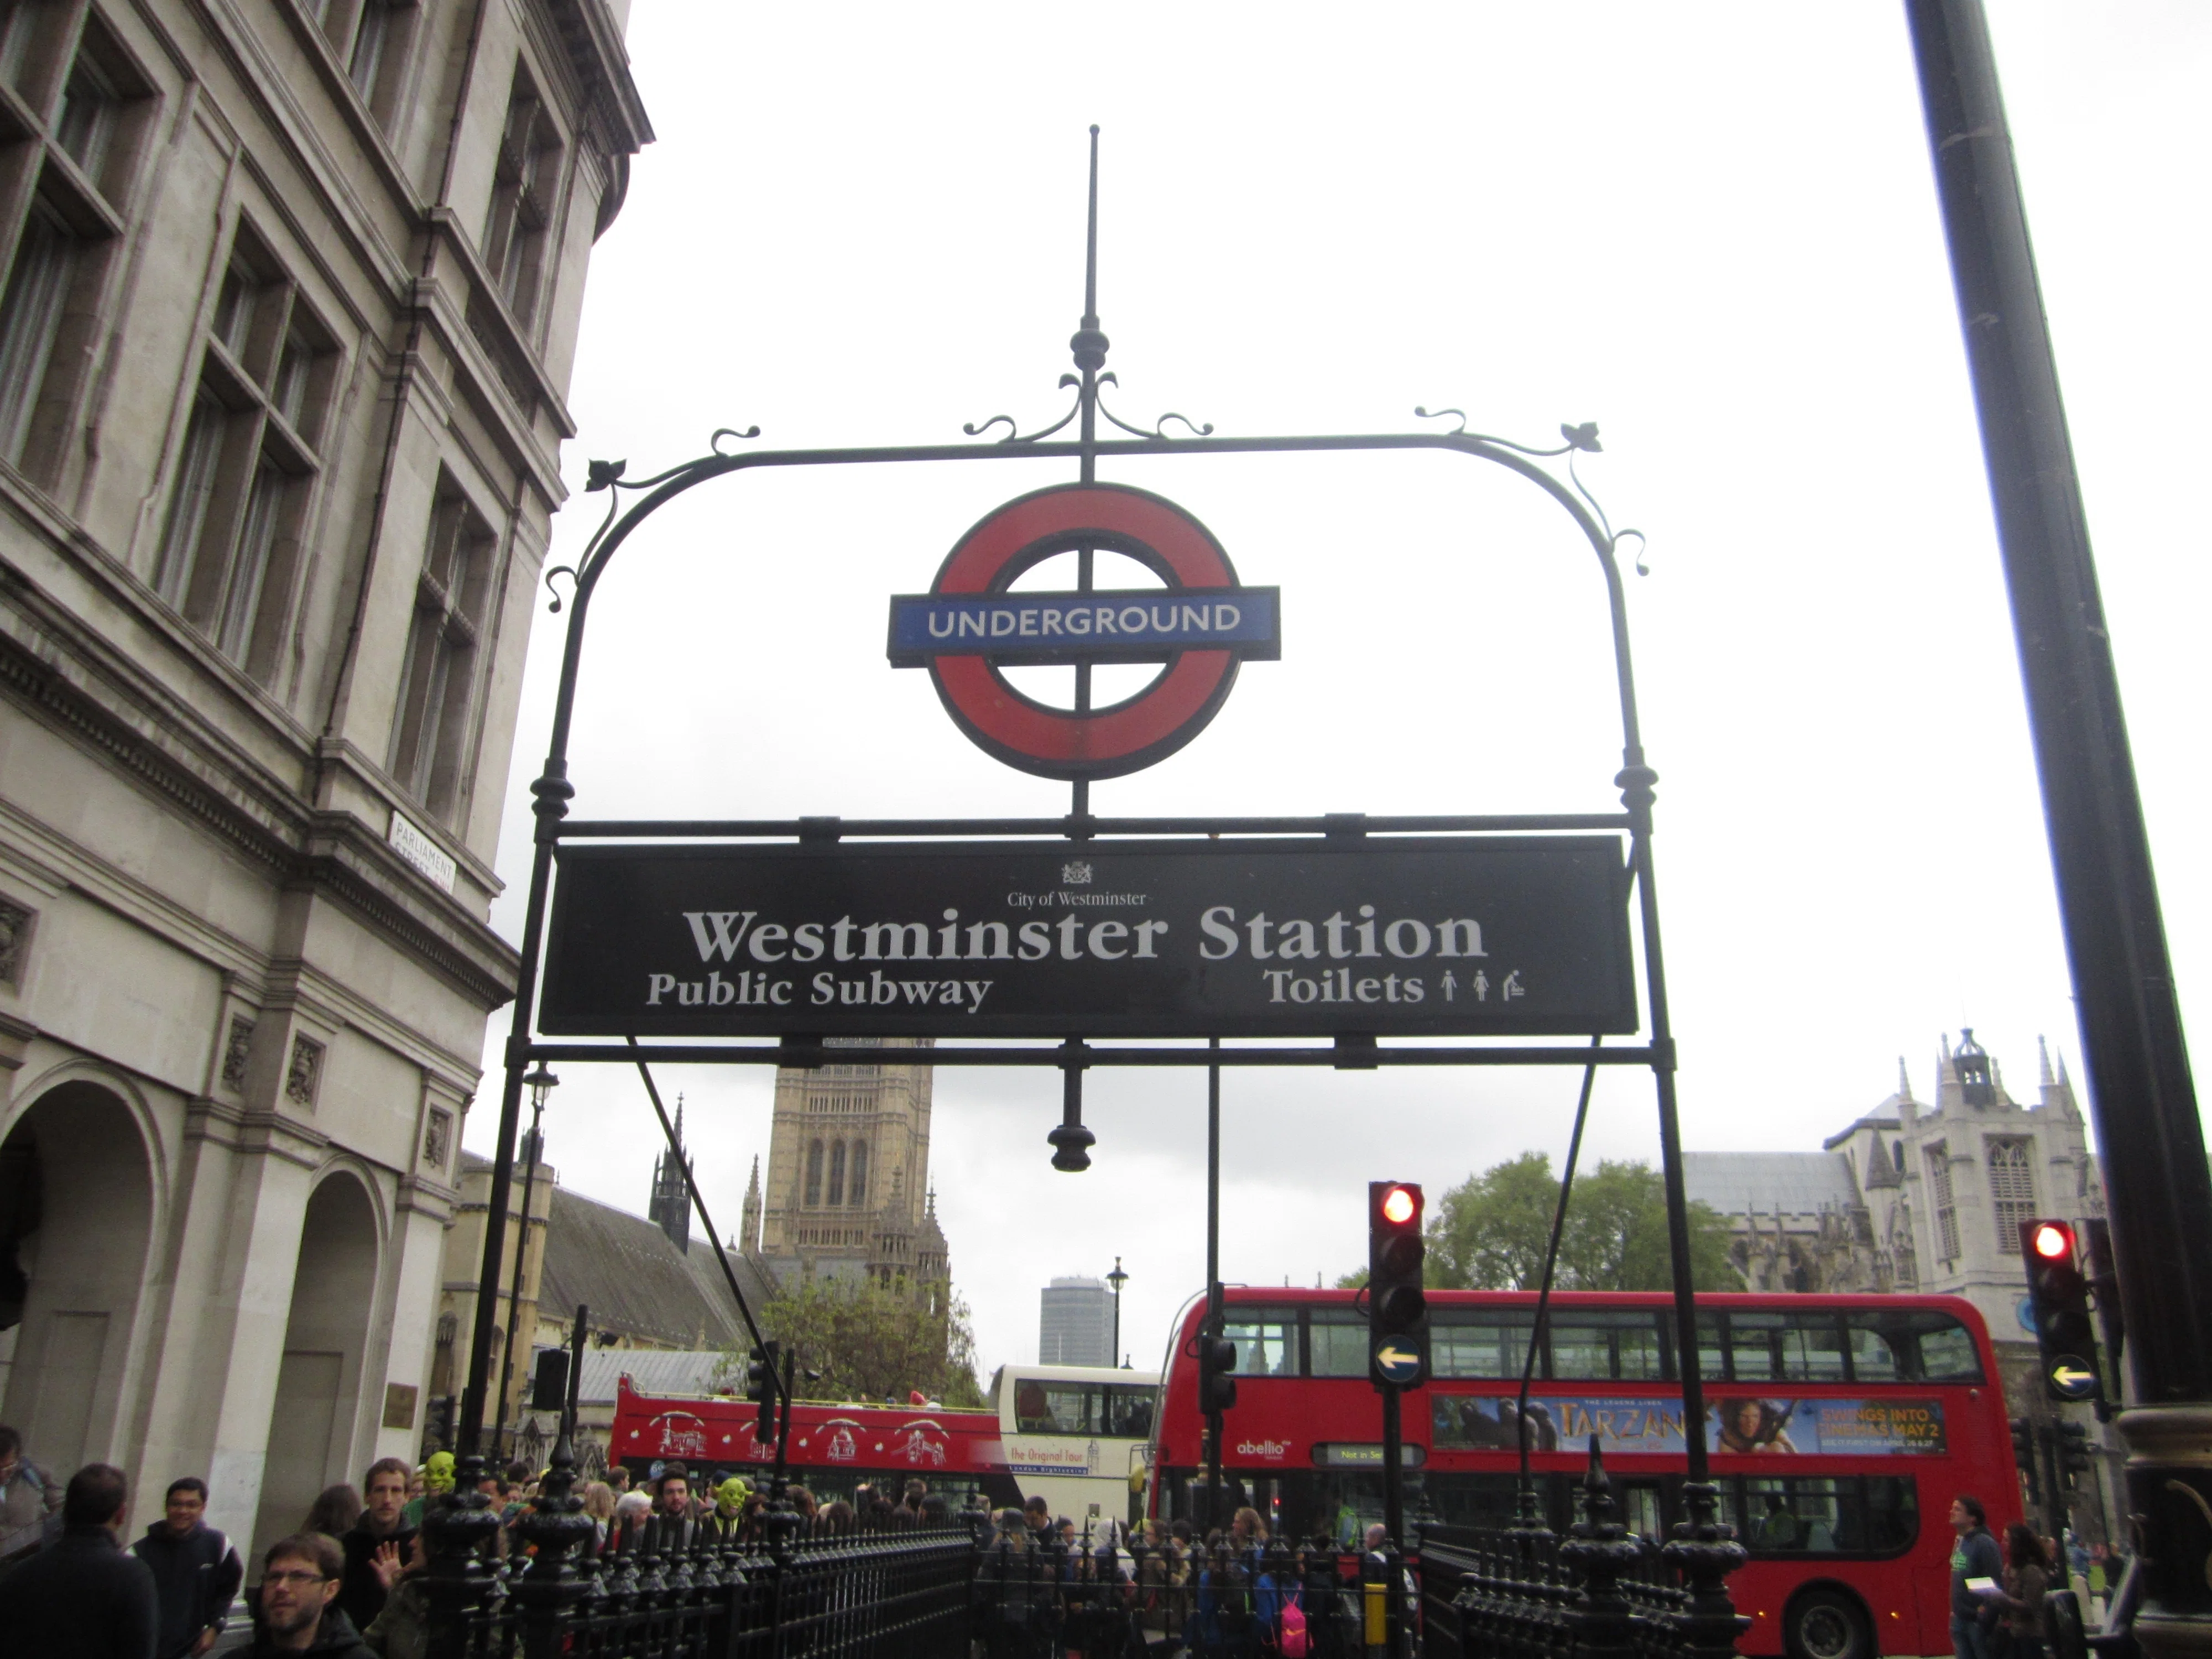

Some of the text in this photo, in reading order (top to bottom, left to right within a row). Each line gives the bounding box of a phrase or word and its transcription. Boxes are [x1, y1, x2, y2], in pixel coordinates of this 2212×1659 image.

[928, 604, 1241, 638] UNDERGROUND
[397, 821, 452, 879] PARLIAMENT
[1008, 891, 1146, 910] City of Westminster
[683, 905, 1488, 962] Westminster Station
[646, 971, 993, 1014] Public Subway
[1262, 968, 1425, 1003] Toilets
[1553, 1402, 1686, 1440] TARZAN
[1822, 1408, 1929, 1422] SWINGS INTO
[1818, 1423, 1939, 1437] CINEMAS MAY 2
[1011, 1447, 1083, 1463] The Original Tour
[1237, 1440, 1284, 1454] abellio
[1340, 1451, 1357, 1459] Not
